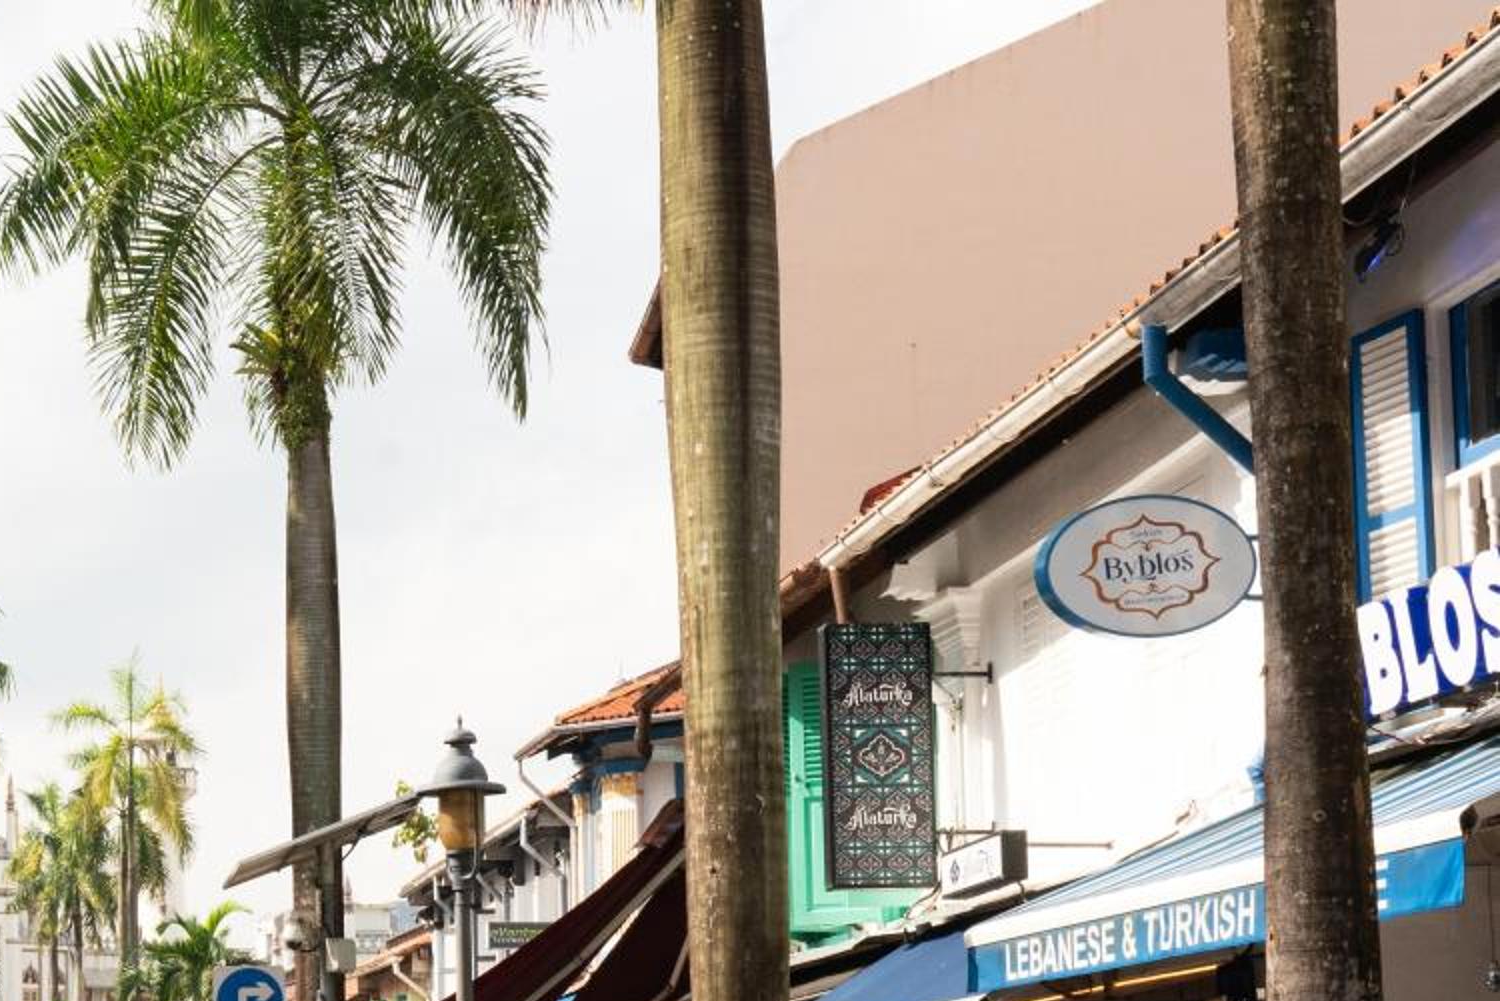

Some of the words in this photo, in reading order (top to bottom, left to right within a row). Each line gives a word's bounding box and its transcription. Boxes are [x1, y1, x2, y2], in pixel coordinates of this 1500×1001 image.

[1104, 550, 1194, 584] Byblos
[844, 680, 913, 706] Alaturka
[849, 806, 918, 830] Alaturka
[1004, 916, 1115, 982] LEBANESE
[1122, 914, 1137, 961] &
[1143, 886, 1257, 954] TURKISH
